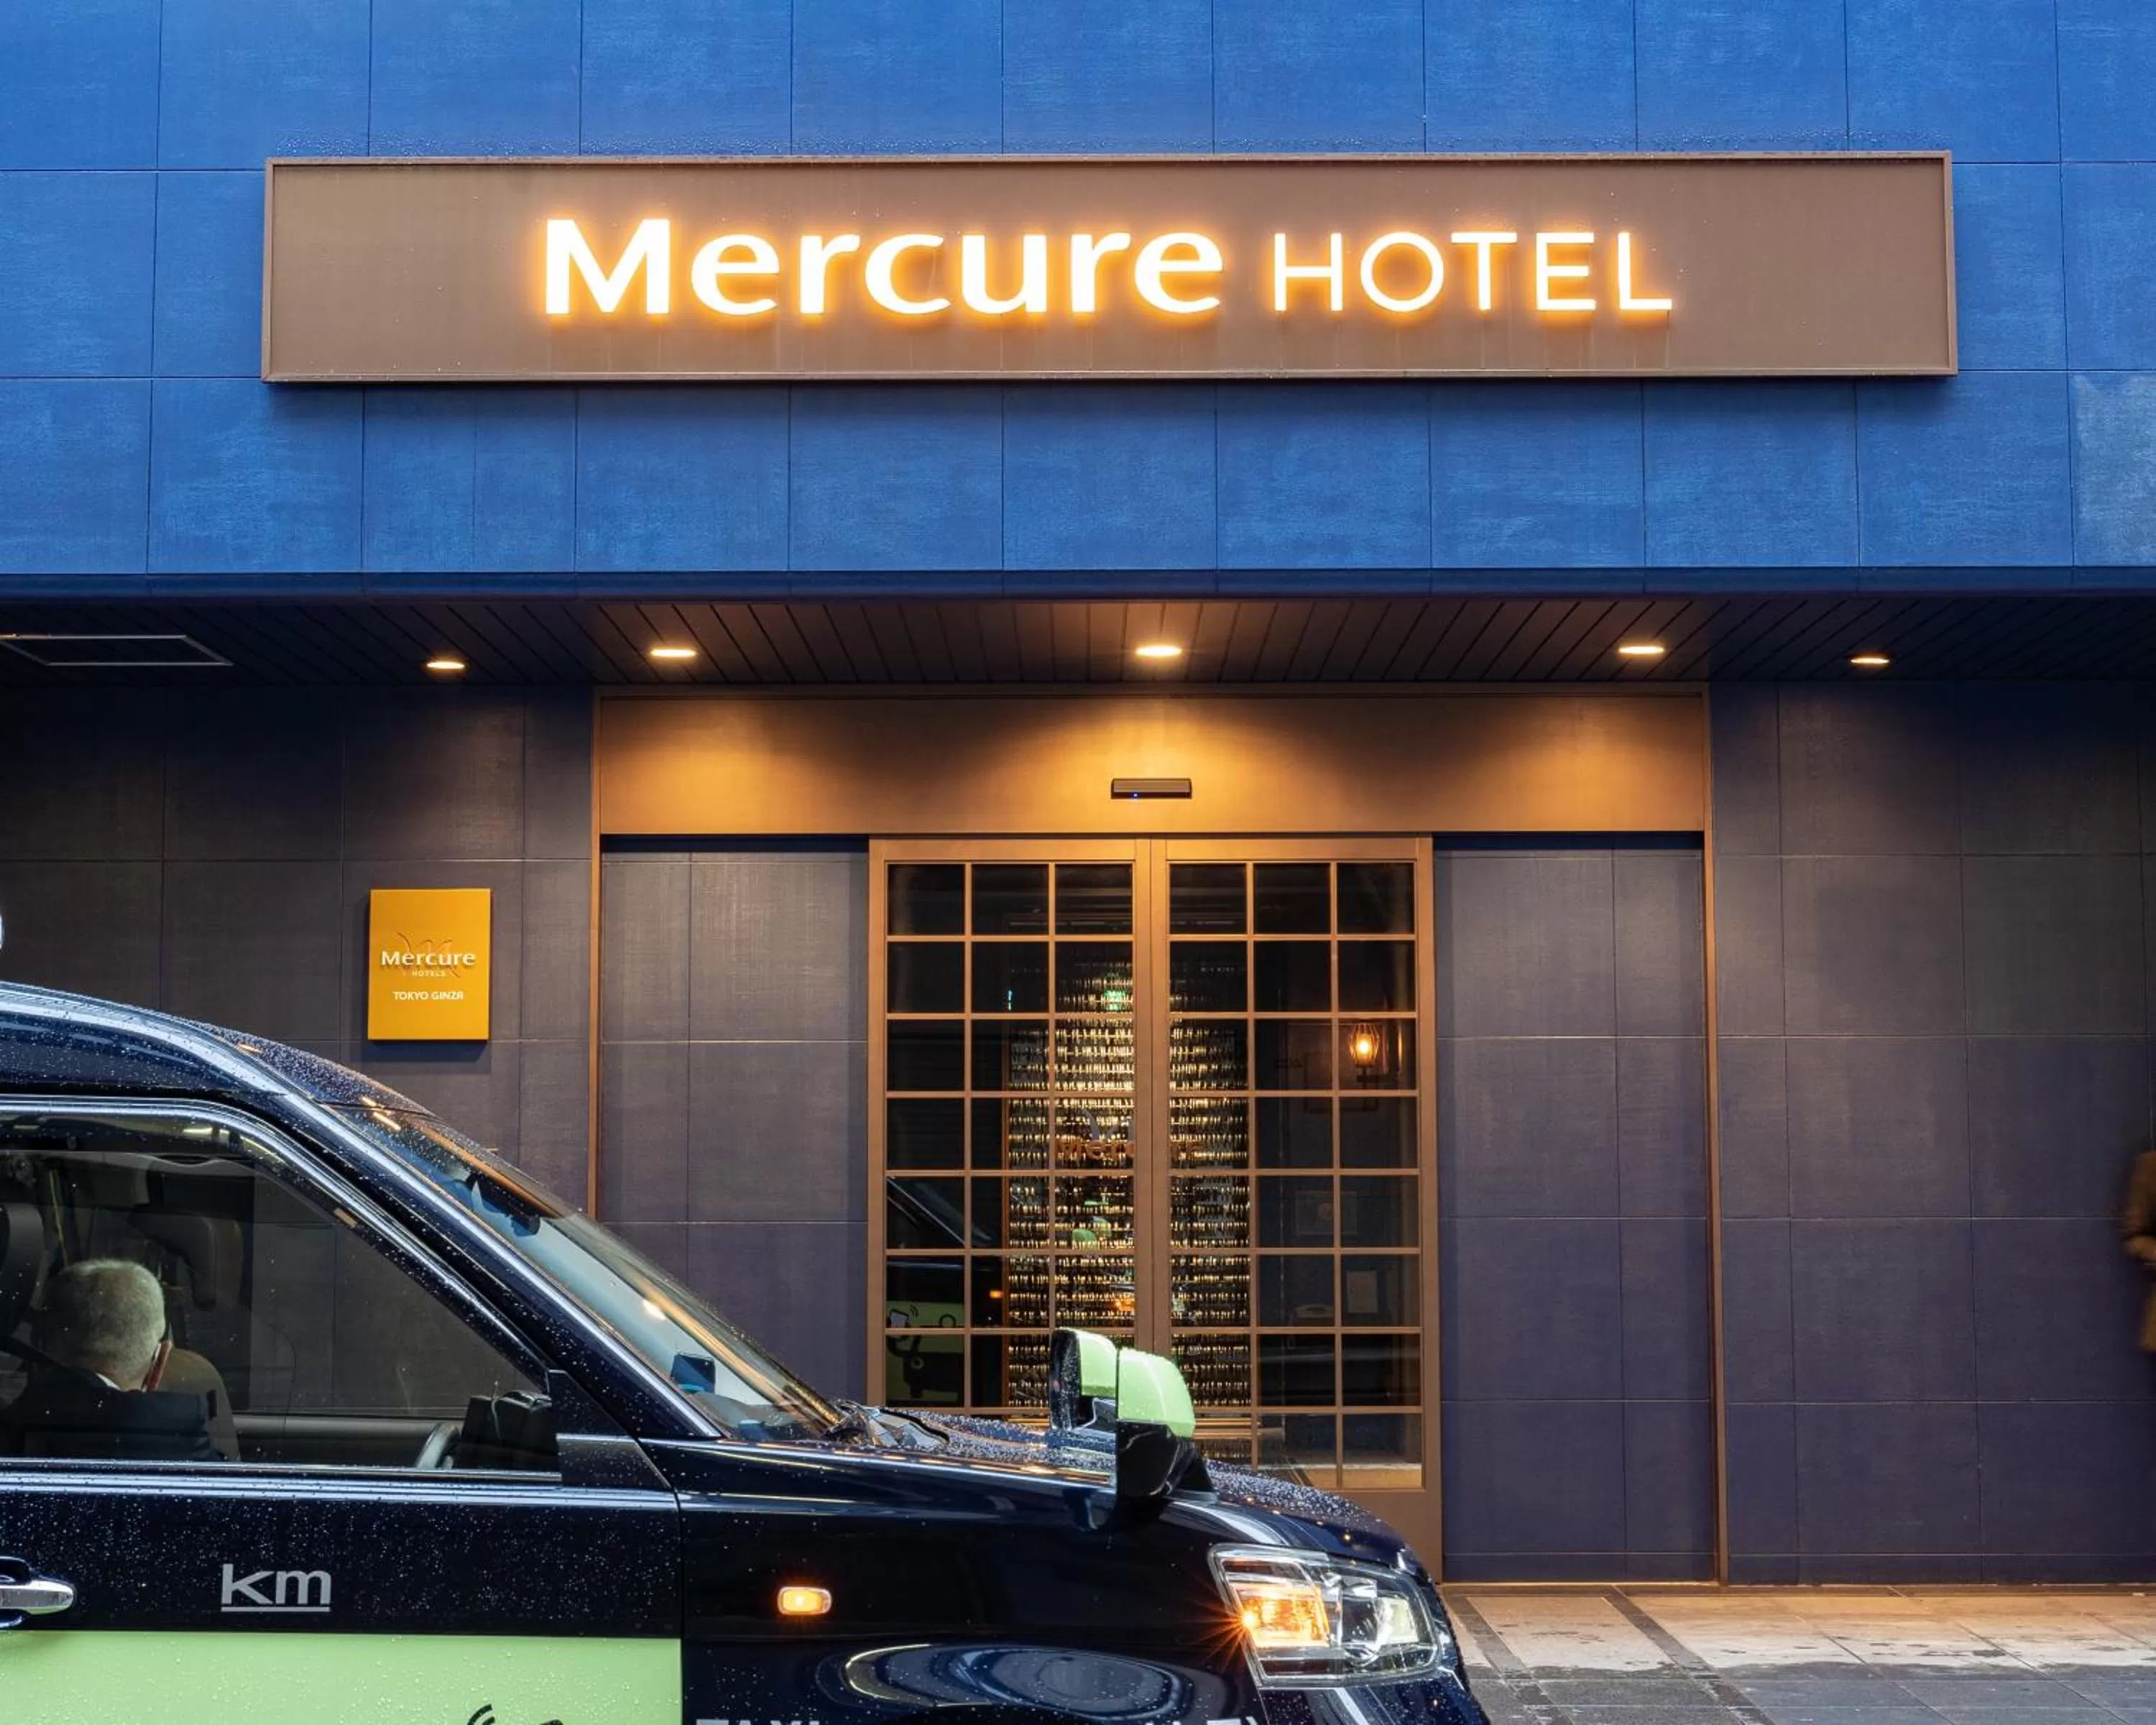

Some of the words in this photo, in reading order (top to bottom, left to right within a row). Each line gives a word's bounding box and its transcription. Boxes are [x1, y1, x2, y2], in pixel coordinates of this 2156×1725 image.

[545, 218, 1223, 315] Mercure
[1273, 231, 1673, 312] HOTEL
[381, 950, 476, 966] Mercure
[393, 991, 429, 1000] TOKYO
[431, 991, 464, 1000] GINZA
[221, 1563, 331, 1605] km
